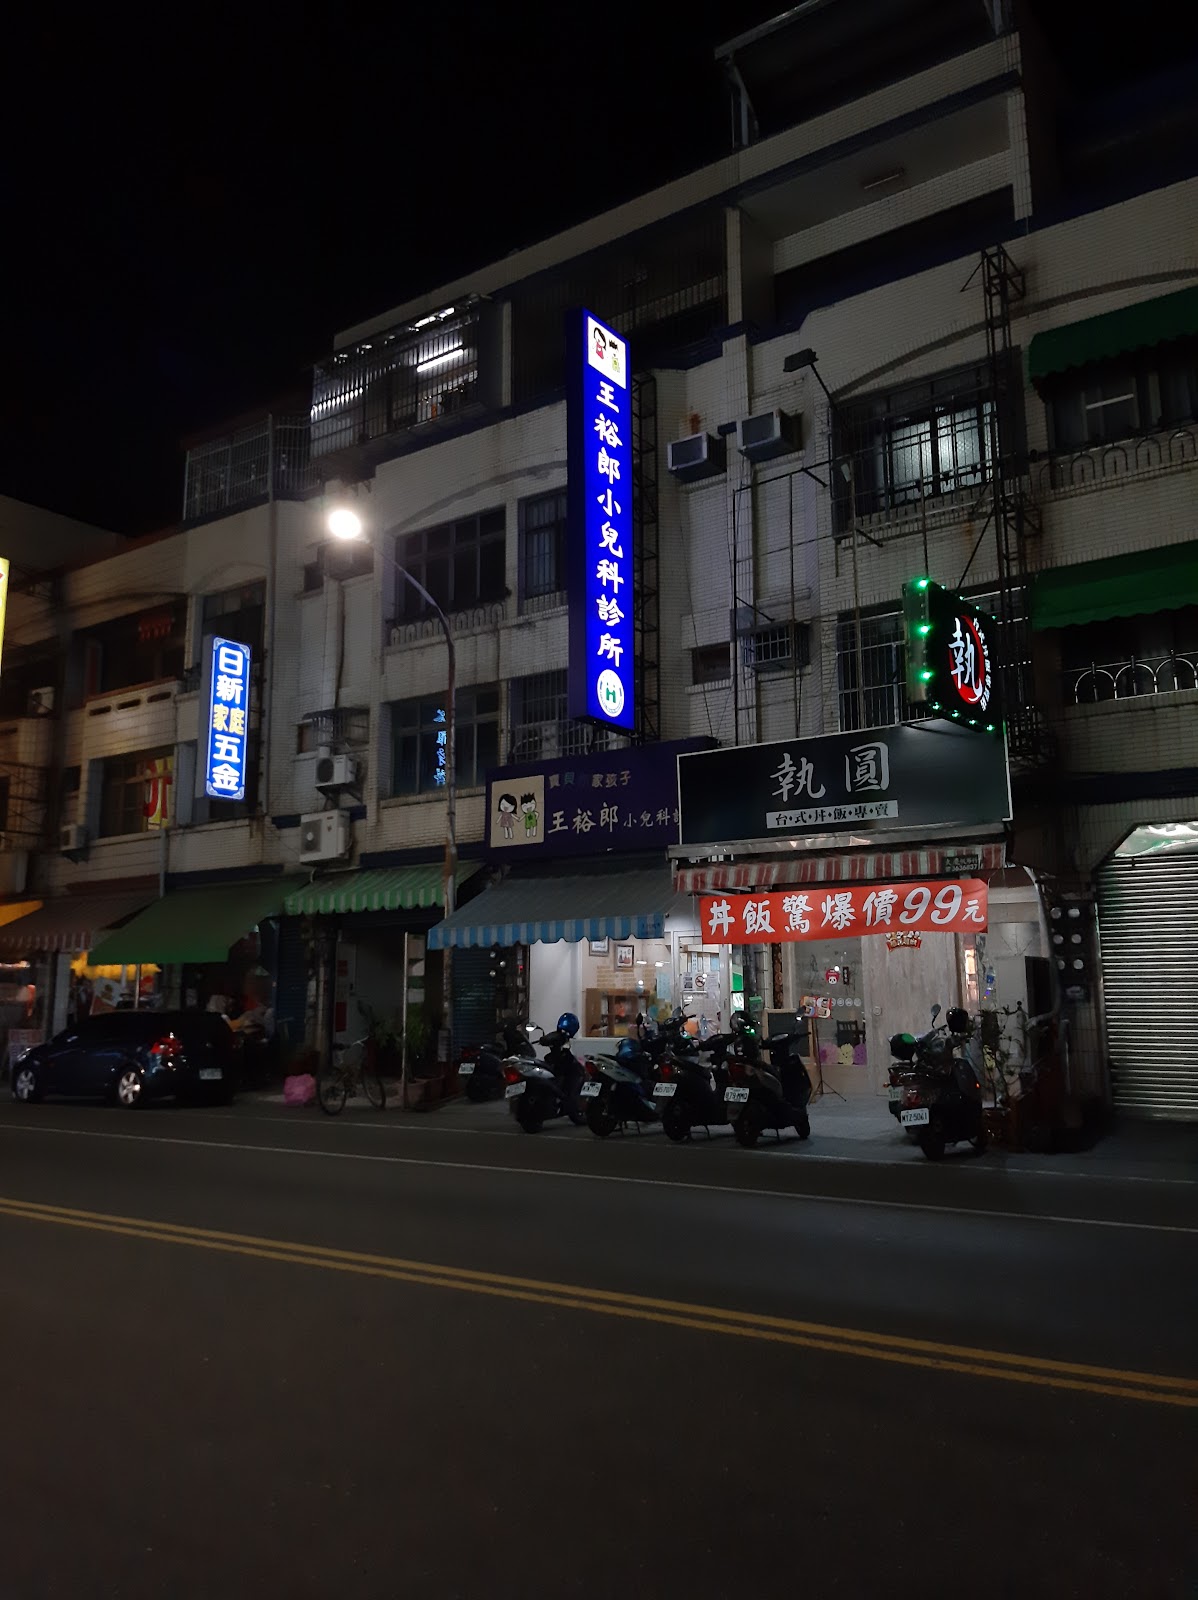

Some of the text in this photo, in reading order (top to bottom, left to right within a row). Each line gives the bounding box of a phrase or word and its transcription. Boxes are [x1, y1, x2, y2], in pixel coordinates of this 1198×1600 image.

[594, 380, 625, 668] 王裕郎小兒科診所
[948, 616, 983, 702] 執
[212, 647, 245, 792] 日新家庭五金
[769, 741, 890, 803] 執圓
